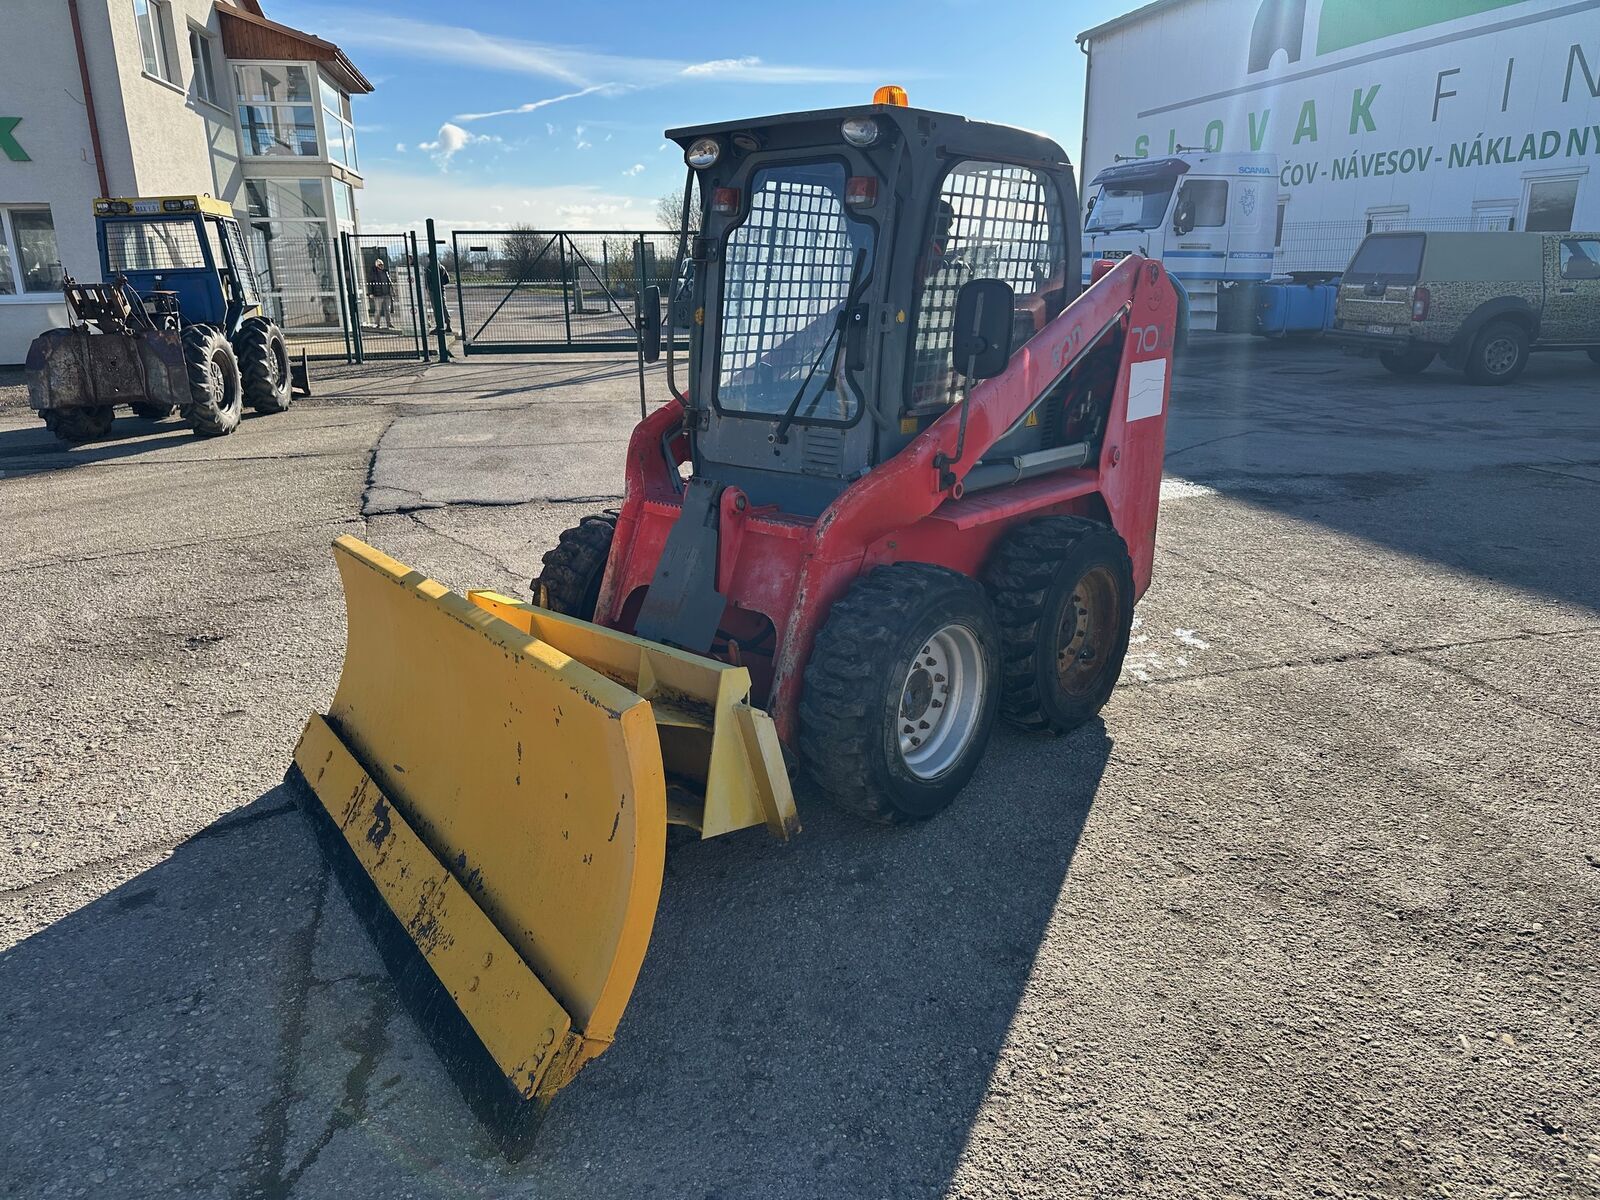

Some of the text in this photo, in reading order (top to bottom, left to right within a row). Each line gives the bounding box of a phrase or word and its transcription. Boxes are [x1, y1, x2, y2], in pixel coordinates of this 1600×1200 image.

[1331, 146, 1433, 181] NÁVESOV
[1238, 166, 1270, 174] SCANIA
[1103, 251, 1124, 259] 143
